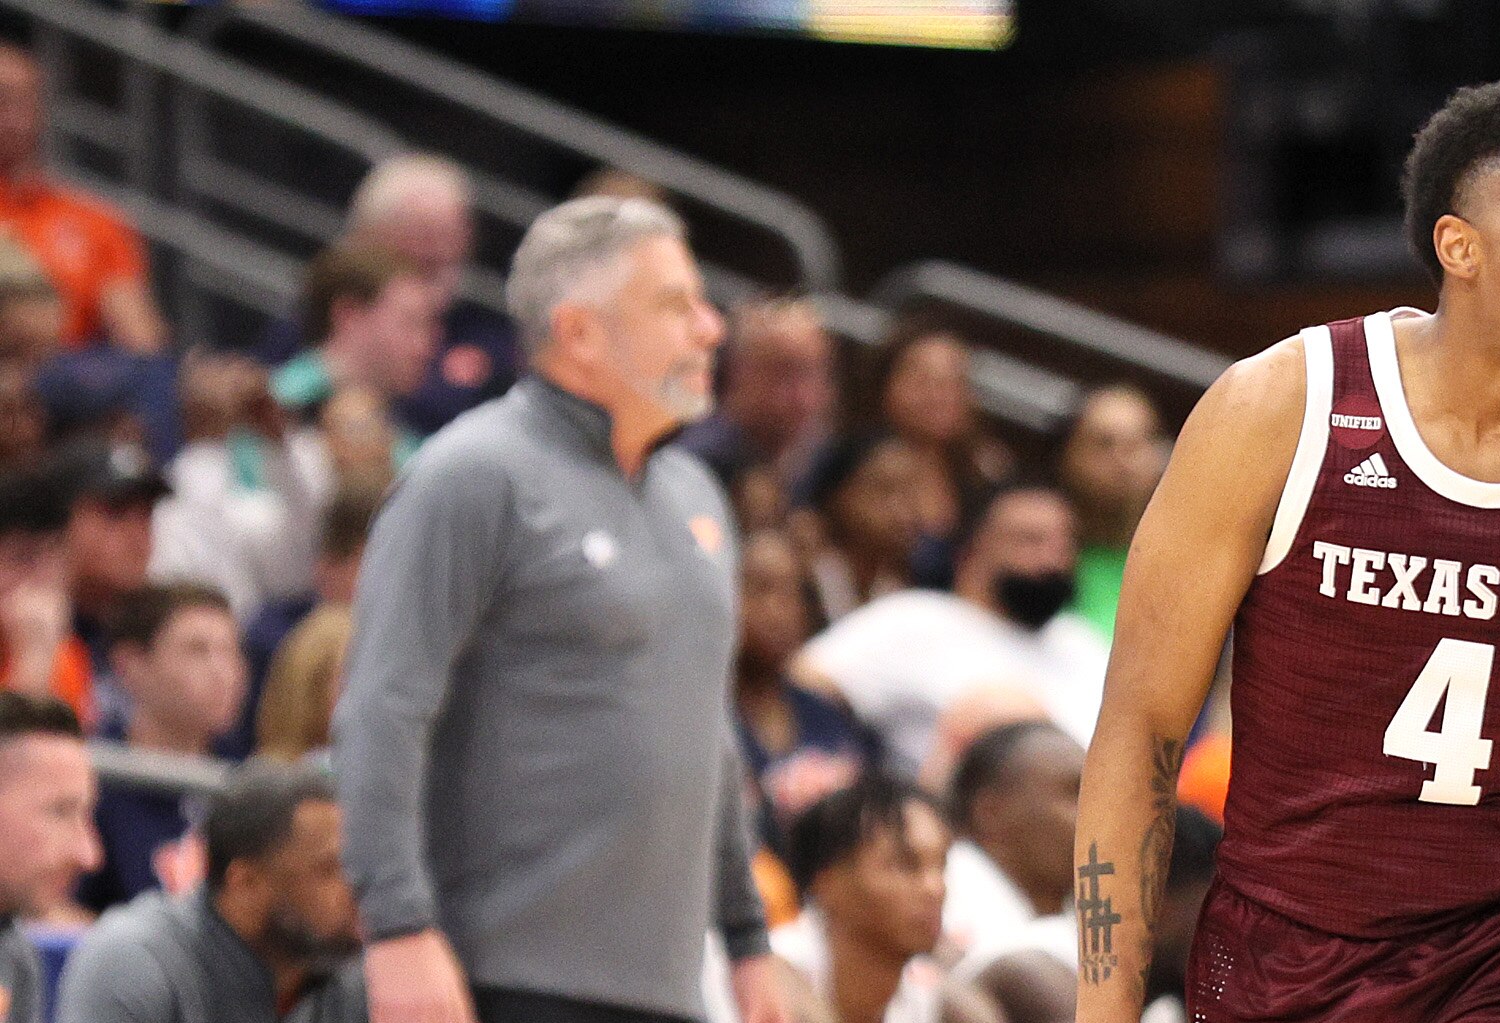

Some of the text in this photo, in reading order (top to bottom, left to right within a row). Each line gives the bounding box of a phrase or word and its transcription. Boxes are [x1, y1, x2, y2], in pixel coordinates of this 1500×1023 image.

[1331, 413, 1382, 431] UNIFIED
[1343, 472, 1398, 489] adidas
[1313, 540, 1500, 620] TEXAS
[1383, 637, 1495, 806] 4
